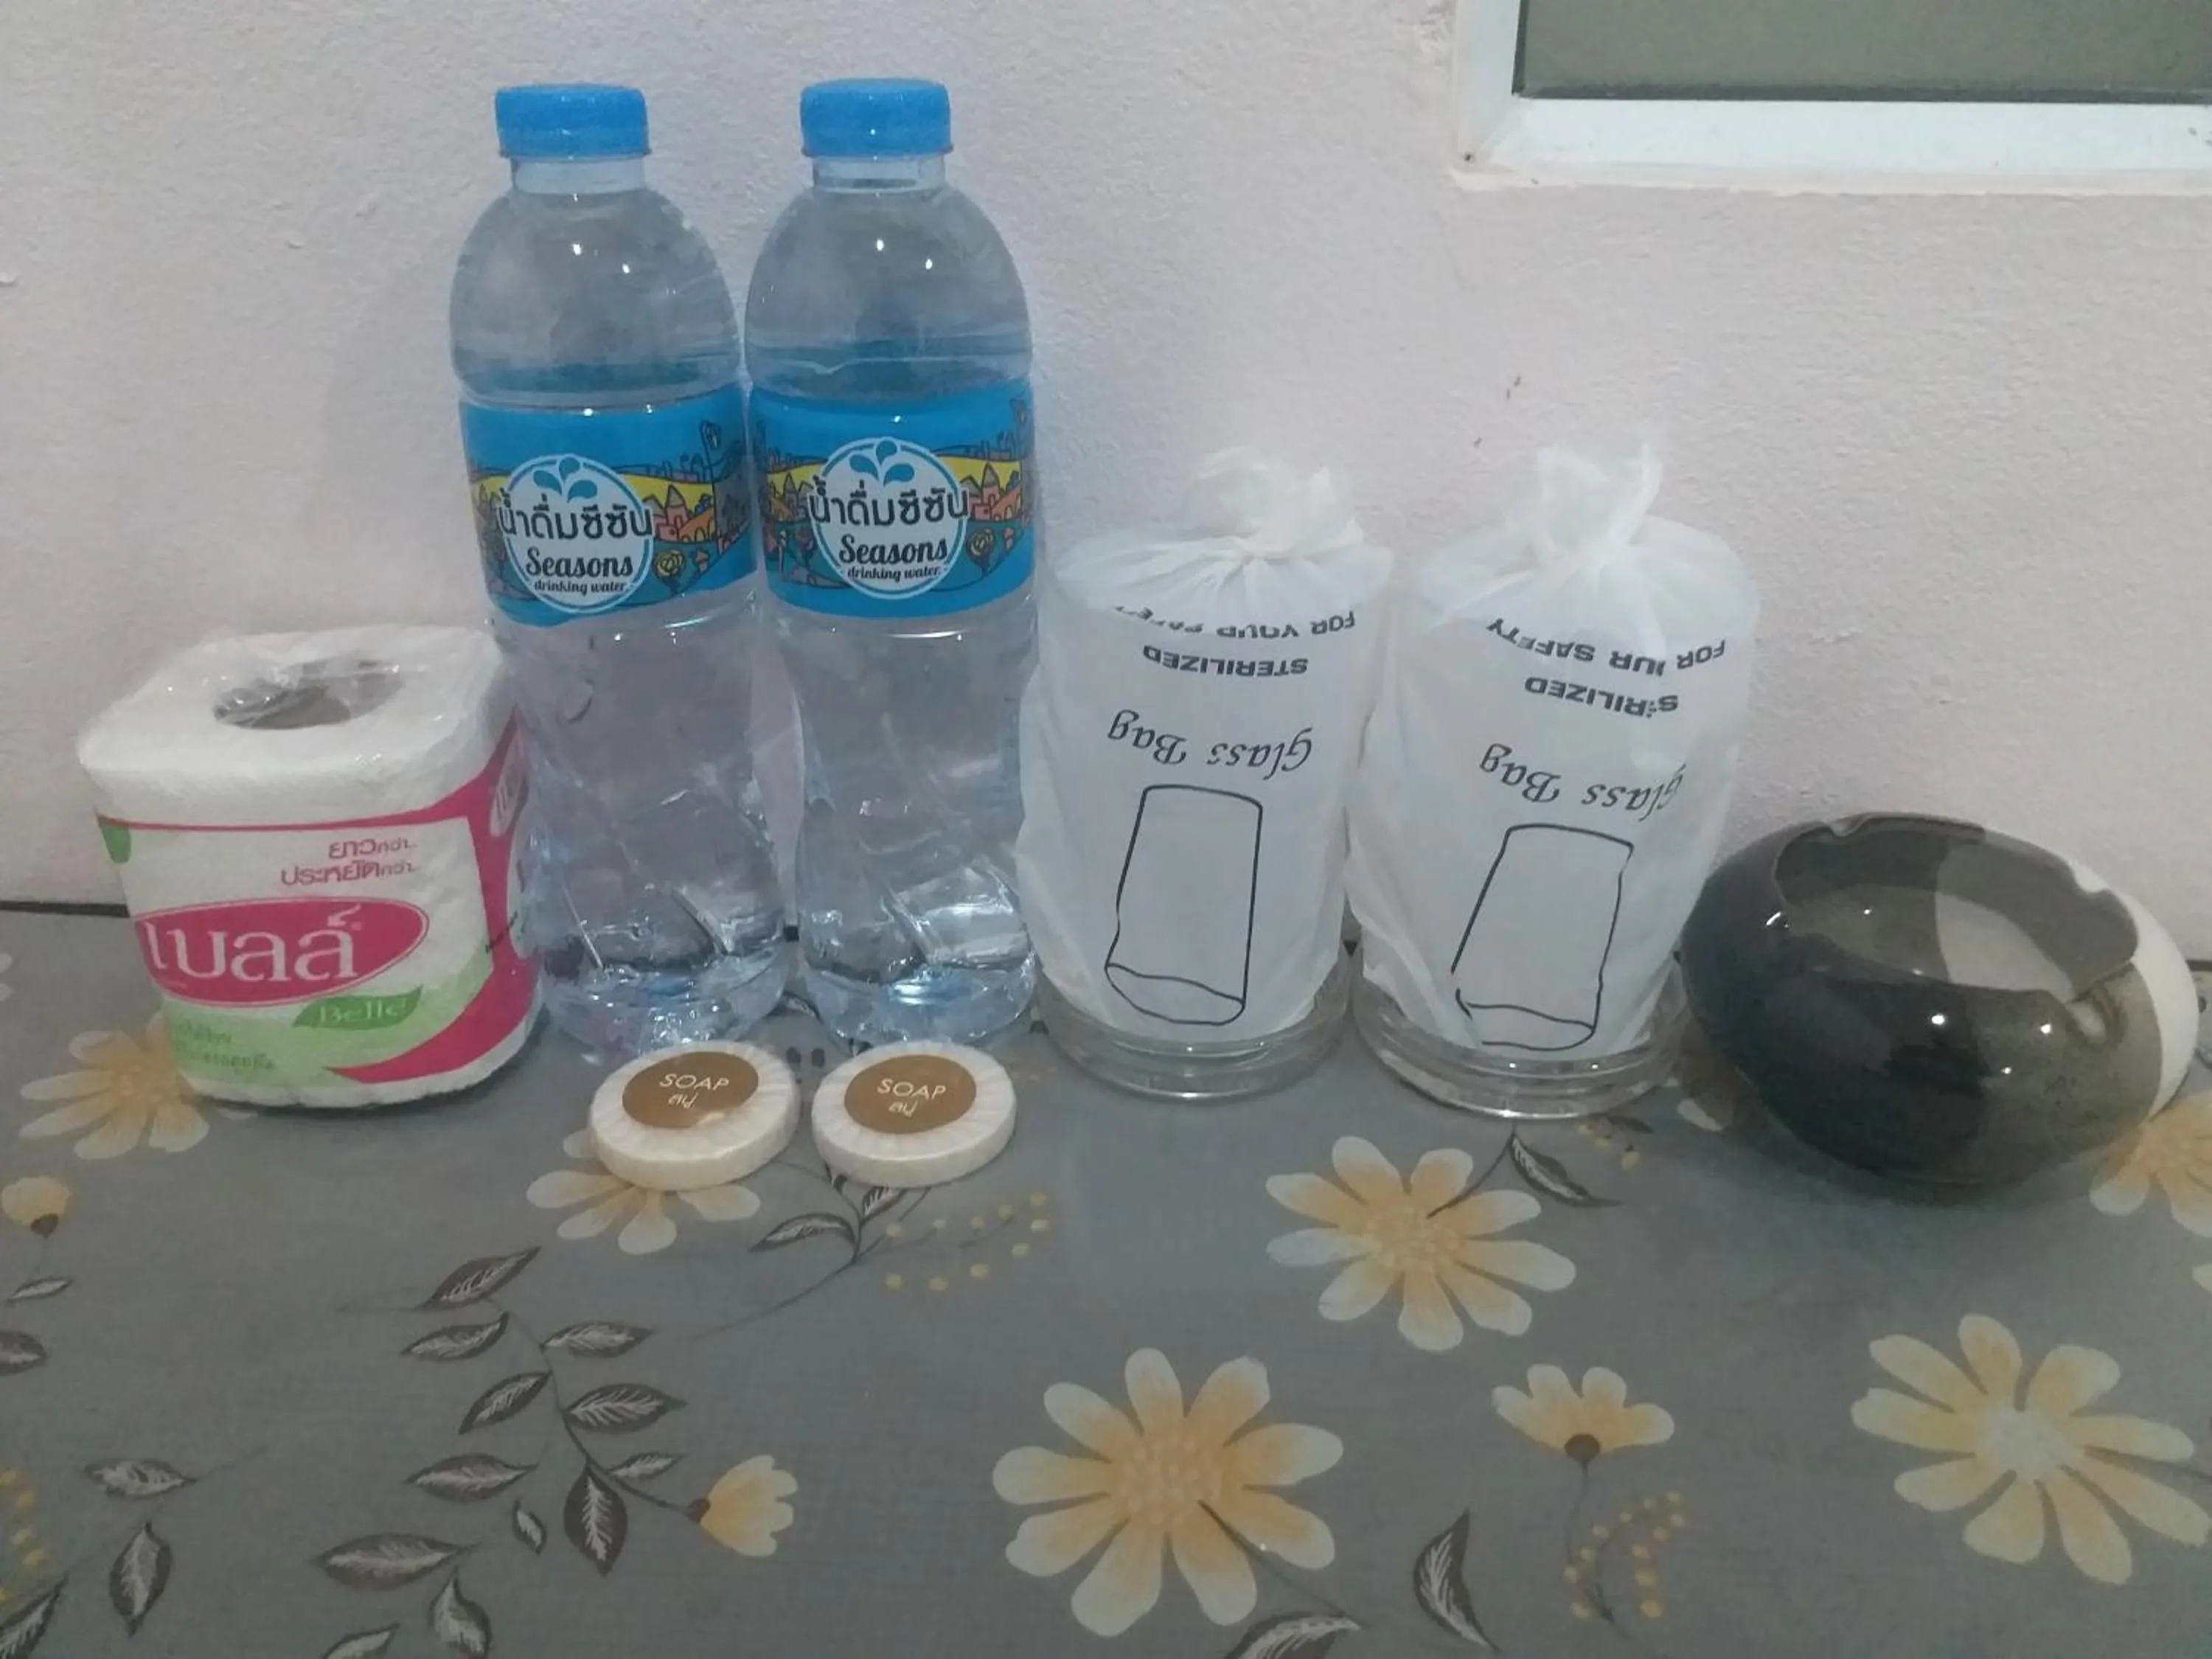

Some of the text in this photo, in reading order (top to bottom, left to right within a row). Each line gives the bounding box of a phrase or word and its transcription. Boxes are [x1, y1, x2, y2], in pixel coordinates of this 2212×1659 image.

[526, 547, 633, 577] Seasons
[838, 534, 948, 565] Seasons
[535, 580, 625, 596] drinking water
[848, 566, 901, 582] drinking
[1310, 611, 1356, 636] FOR
[1142, 644, 1310, 677] STERILIZED
[1677, 639, 1727, 671] FOR
[1107, 709, 1314, 782] Glass Bag
[1478, 743, 1687, 822] Glass Bag
[143, 903, 361, 982] เบลล์
[658, 1073, 729, 1091] SOAP
[877, 1077, 947, 1102] SOAP
